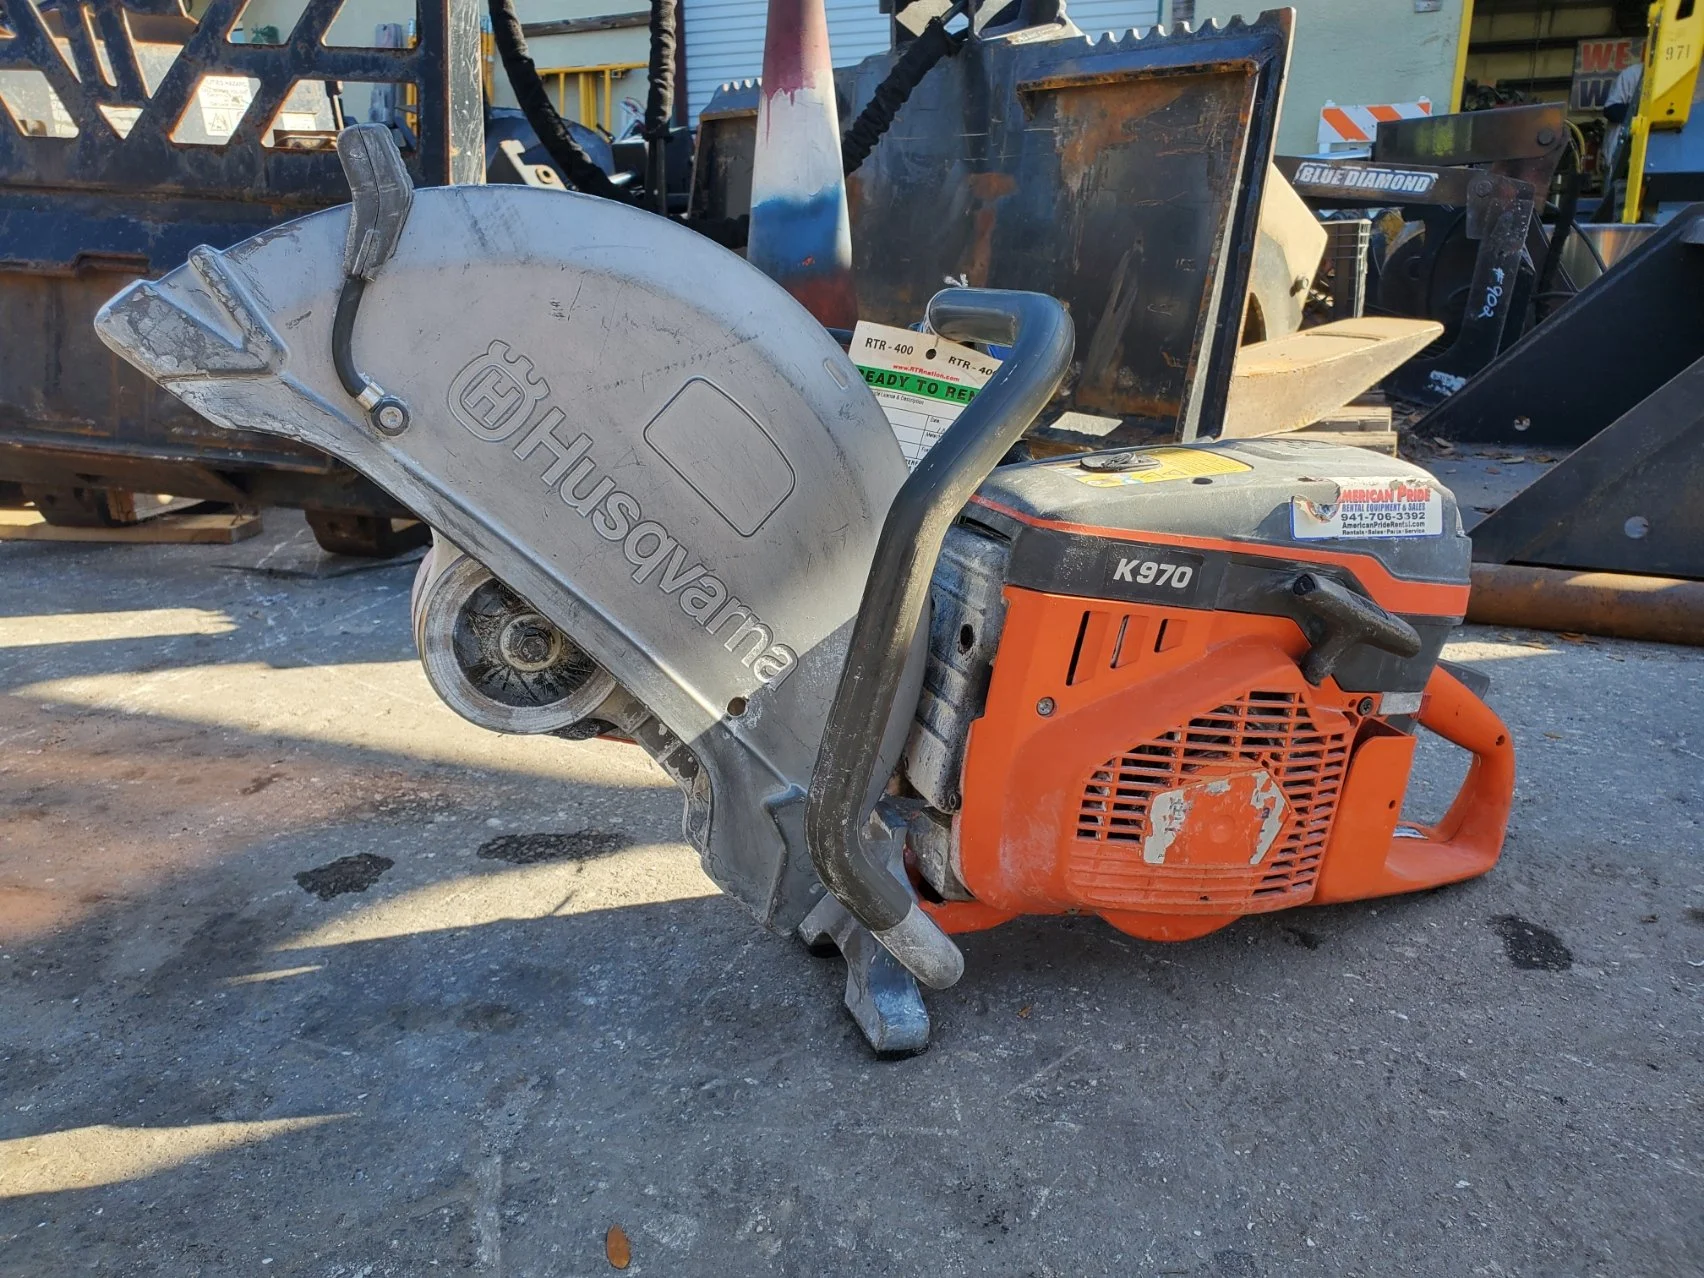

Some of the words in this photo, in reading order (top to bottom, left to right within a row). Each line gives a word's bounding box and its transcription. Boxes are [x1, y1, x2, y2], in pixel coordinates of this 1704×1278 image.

[1300, 167, 1345, 185] BLUE
[1344, 171, 1431, 193] DIAMOND
[865, 337, 887, 351] RTR
[894, 343, 914, 356] 400
[948, 356, 971, 370] RTR
[892, 363, 961, 383] www.RTRnation.com
[916, 379, 939, 395] TO
[1341, 512, 1426, 521] 941-706-3392
[1342, 504, 1365, 513] RENTAL
[1366, 503, 1401, 512] EQUIPMENT
[1408, 503, 1426, 512] SALES
[512, 405, 799, 691] Husqvarna
[1112, 558, 1194, 590] K970
